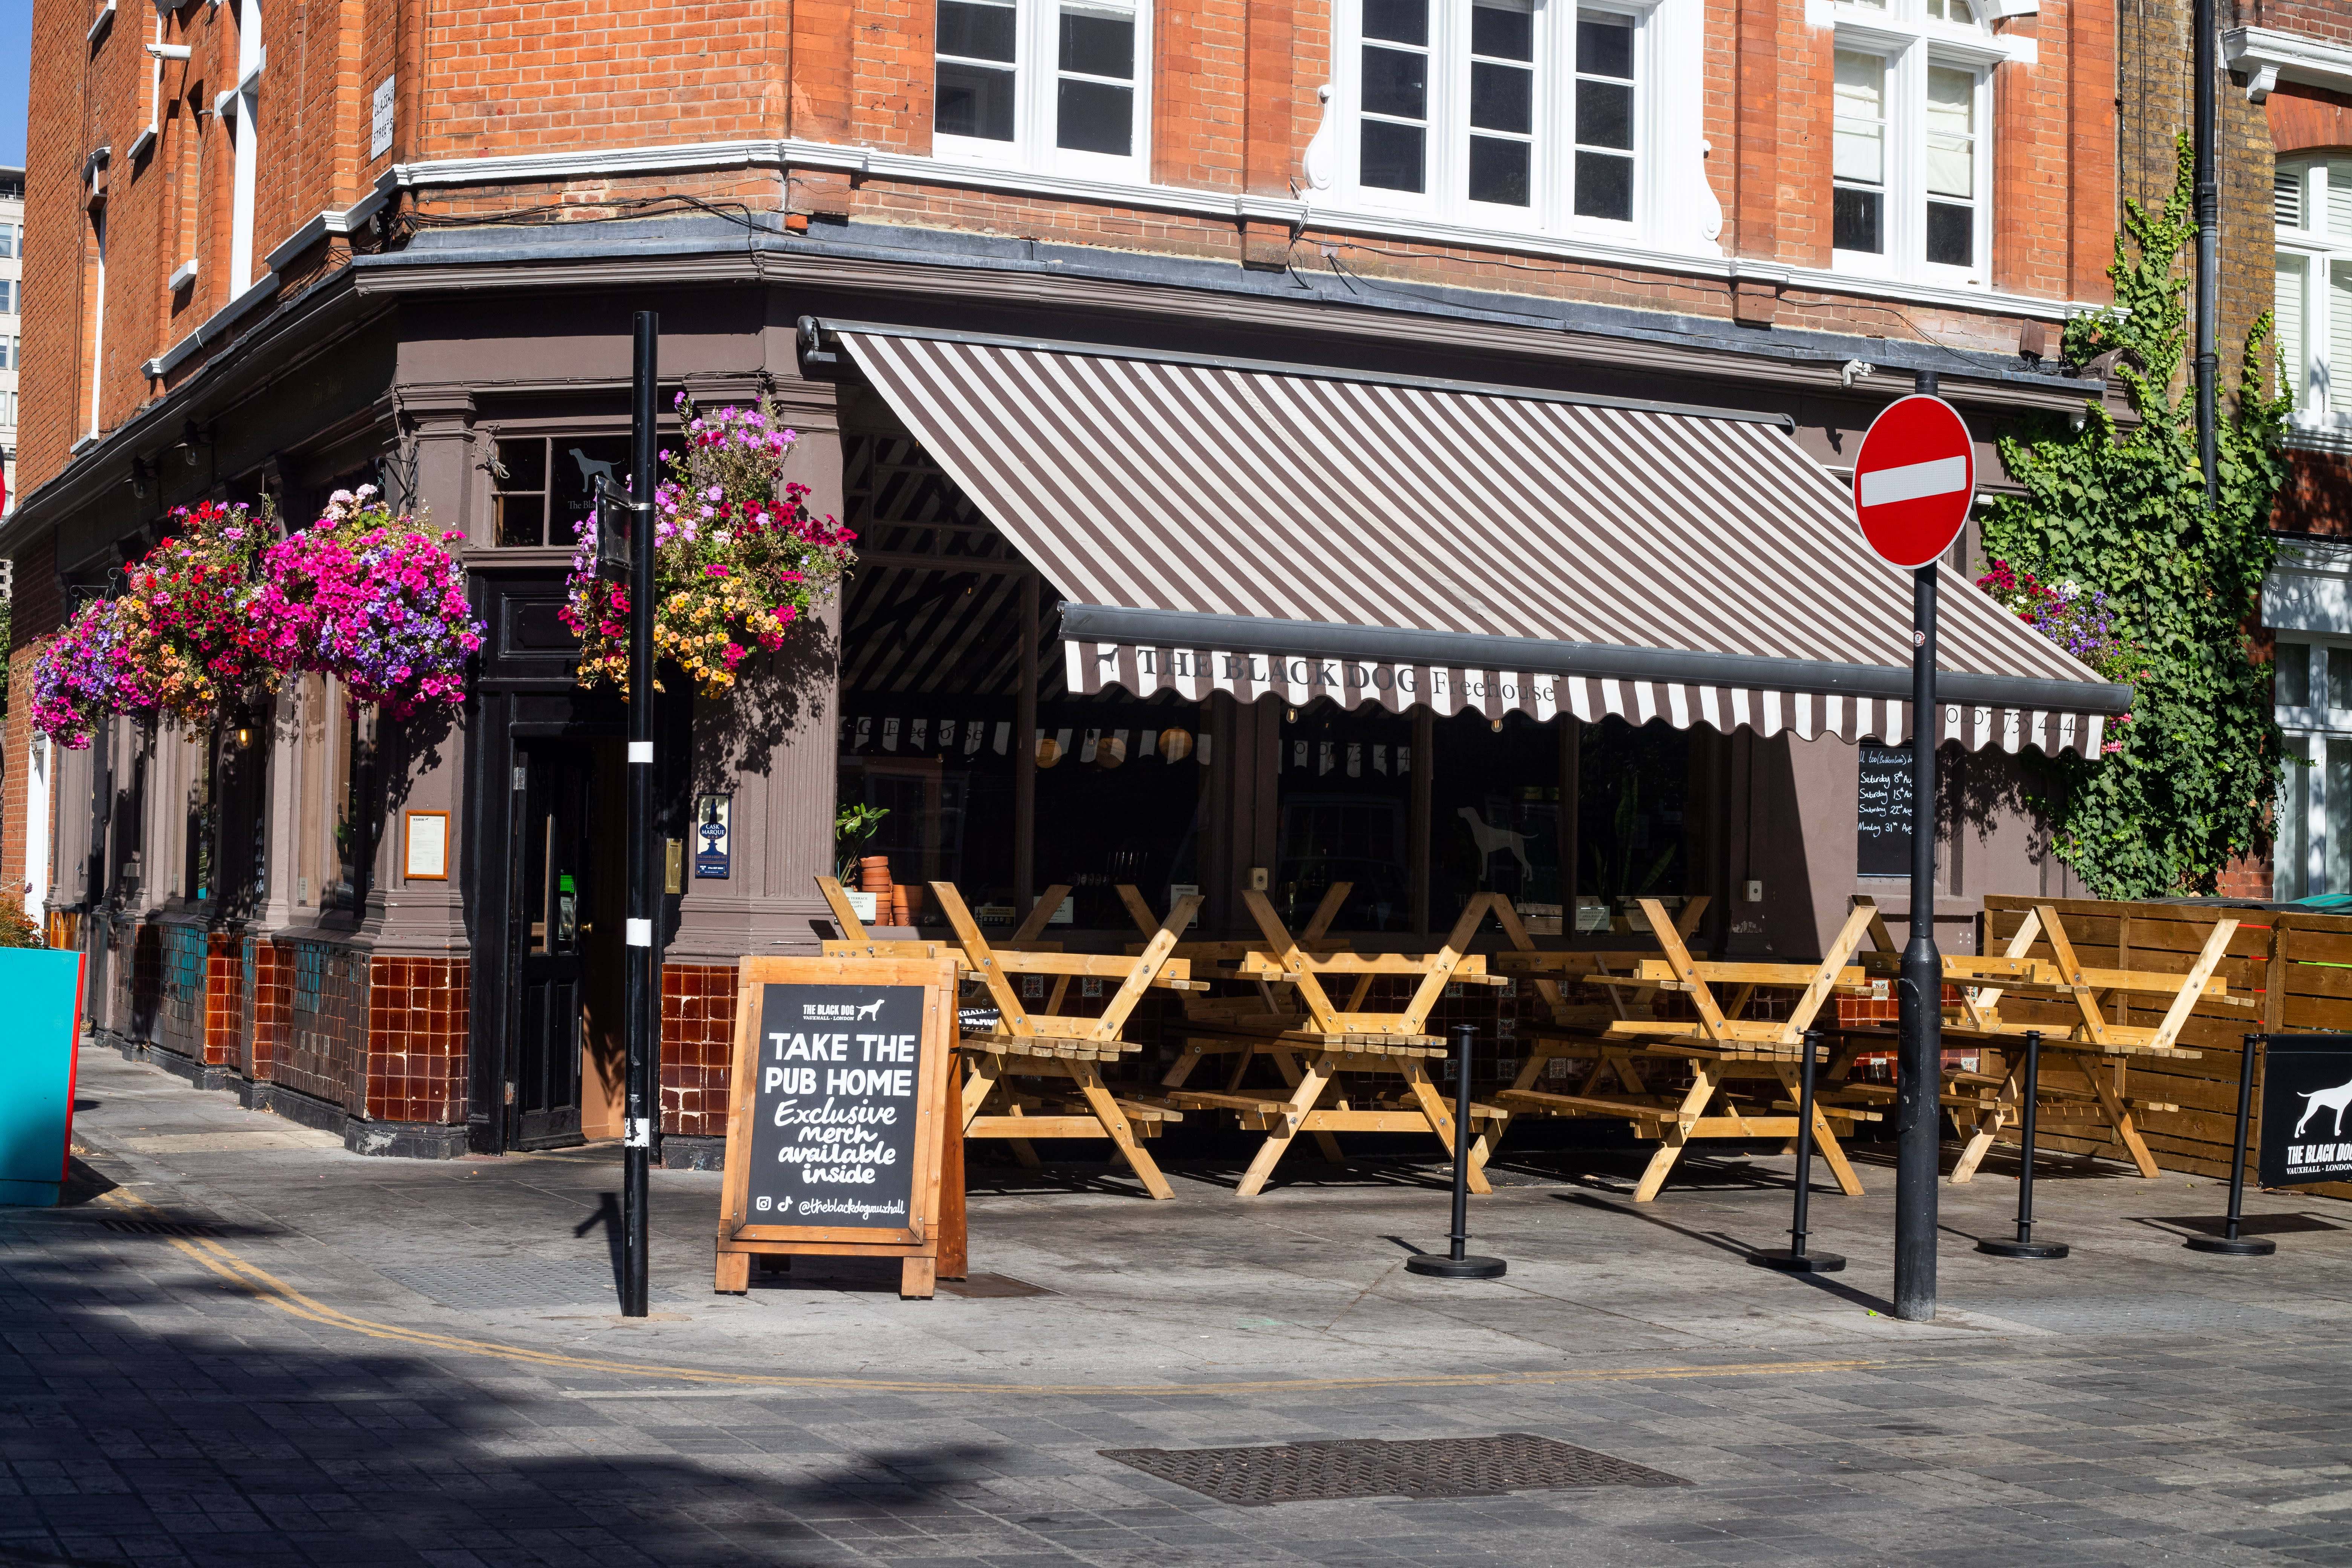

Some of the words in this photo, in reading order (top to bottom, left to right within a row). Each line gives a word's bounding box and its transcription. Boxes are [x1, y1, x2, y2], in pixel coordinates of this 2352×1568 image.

[568, 501, 582, 509] The
[1138, 649, 1213, 677] THE
[1222, 655, 1339, 687] BLACK
[1345, 664, 1419, 692] DOG
[1432, 671, 1555, 701] Freehouse
[1946, 708, 1995, 732] 0207
[2004, 712, 2031, 735] 735
[2038, 714, 2088, 738] 4440
[1860, 772, 1890, 789] Saturday
[1894, 771, 1903, 783] 8th
[1859, 788, 1888, 805] Saturday
[1893, 787, 1904, 800] 15th
[1859, 804, 1886, 817] Saturday
[1890, 804, 1903, 814] 22nd
[1858, 821, 1881, 838] Monday
[1885, 822, 1898, 832] 31st
[803, 1004, 816, 1015] THE
[817, 1004, 839, 1015] BLACK
[841, 1005, 854, 1015] DOG
[769, 1033, 848, 1061] TAKE
[856, 1035, 916, 1062] THE
[765, 1067, 816, 1095] PUB
[826, 1069, 912, 1096] HOME
[774, 1096, 897, 1127] Exclusive
[798, 1124, 878, 1144] merch
[778, 1141, 896, 1165] available
[2288, 1145, 2305, 1165] THE
[2305, 1144, 2337, 1163] BLACK
[802, 1163, 876, 1184] inside
[2286, 1165, 2321, 1175] VAUXHALL
[799, 1198, 905, 1220] @theblackdogvauxhall
